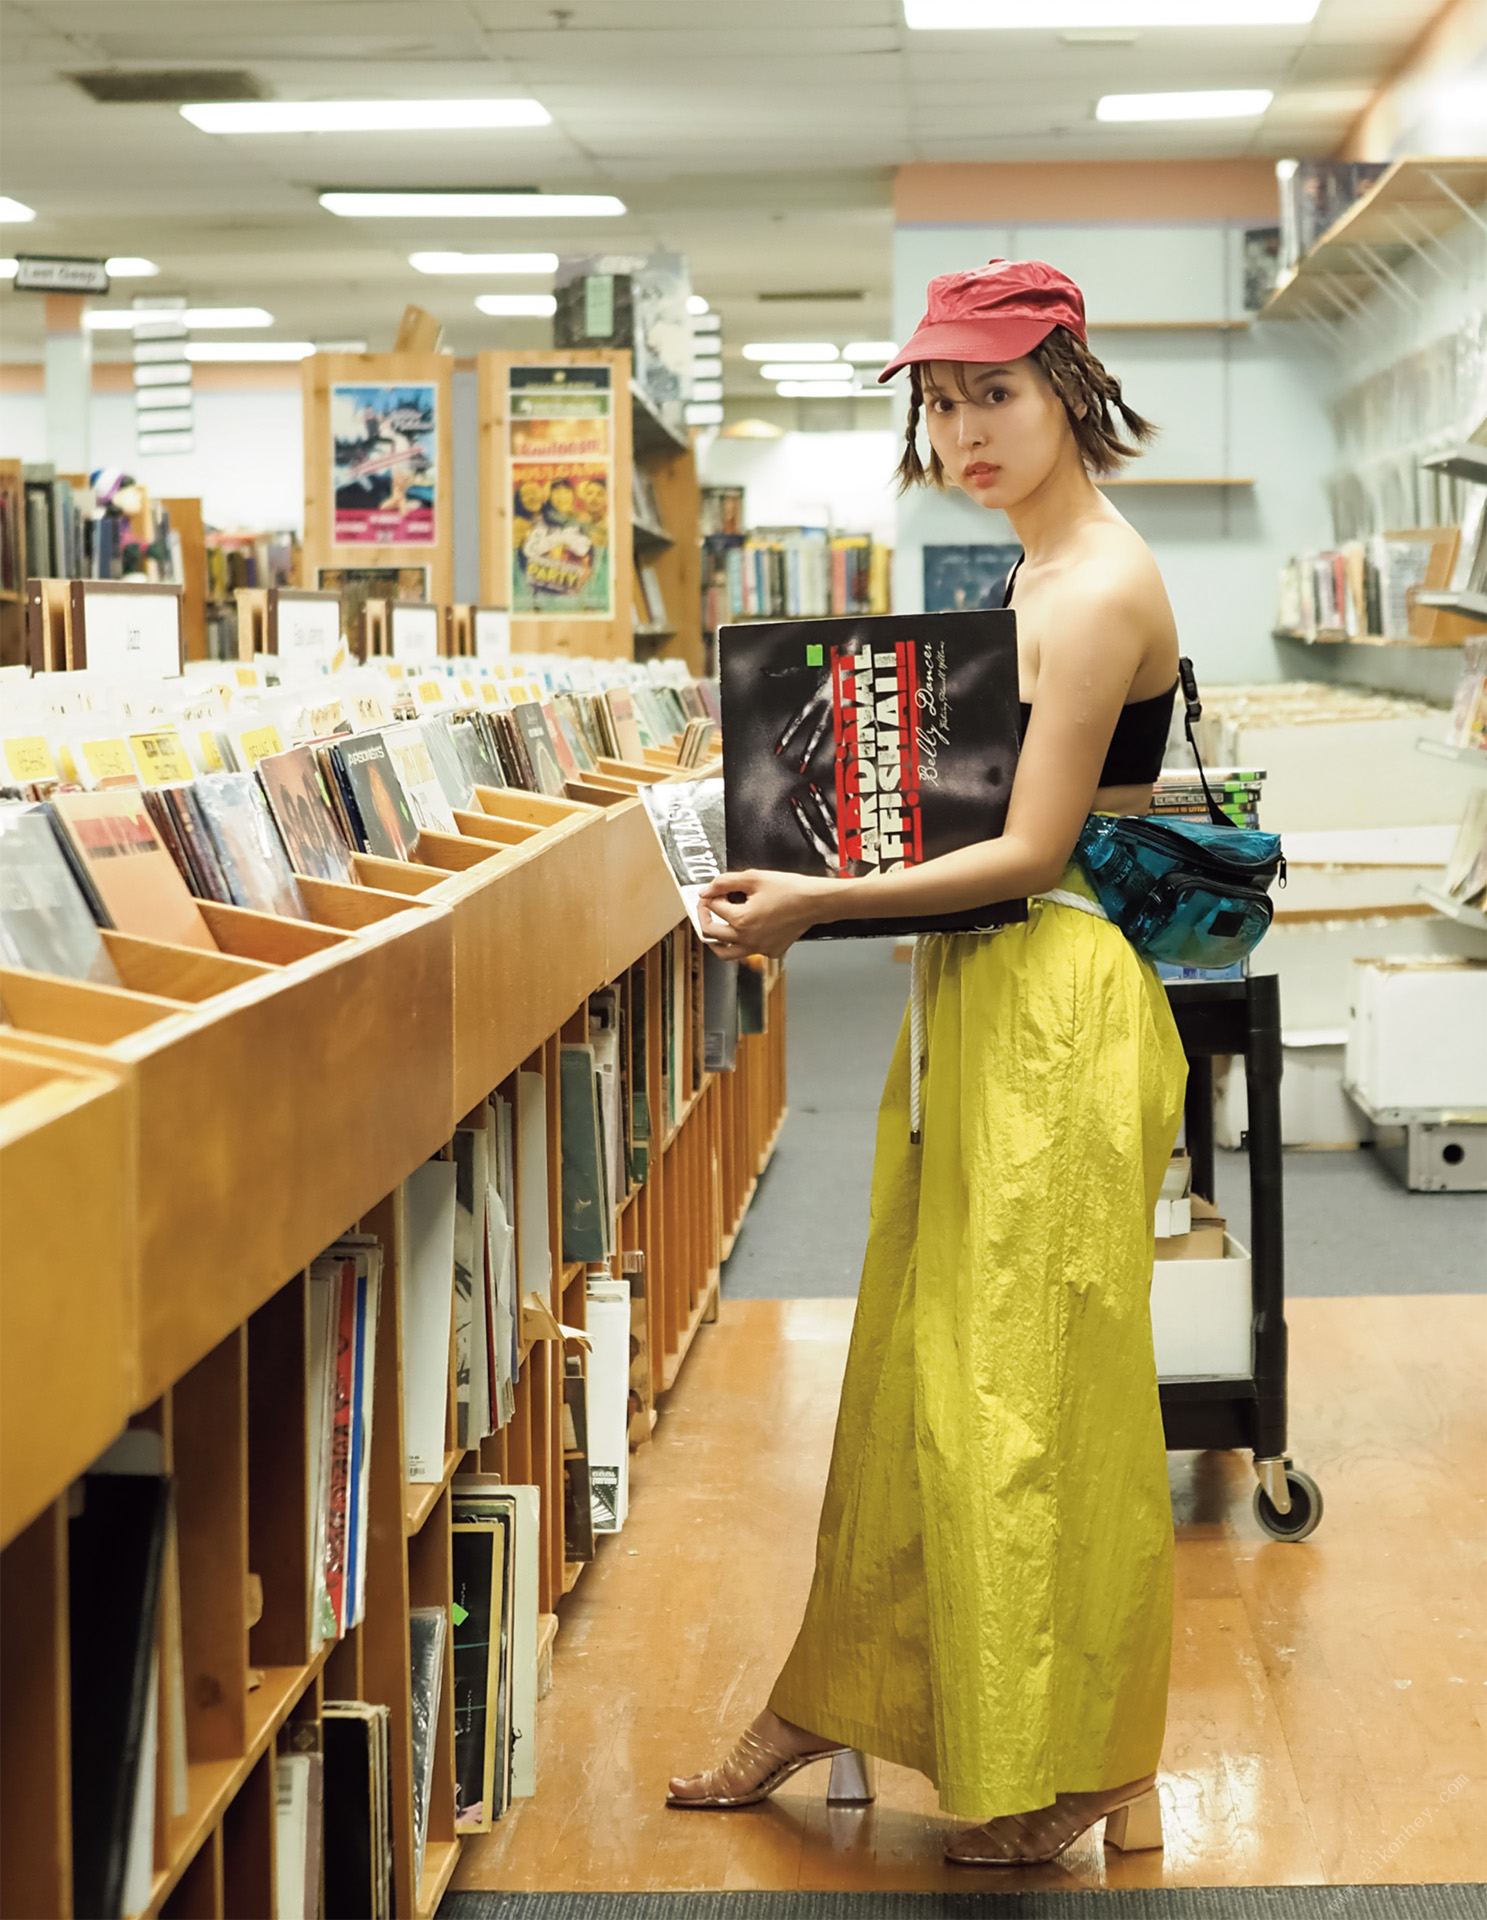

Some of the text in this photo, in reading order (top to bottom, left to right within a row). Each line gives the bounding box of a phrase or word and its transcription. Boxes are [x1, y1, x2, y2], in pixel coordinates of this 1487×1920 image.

[526, 562, 578, 586] PARTY
[914, 641, 951, 786] Belly Dancer
